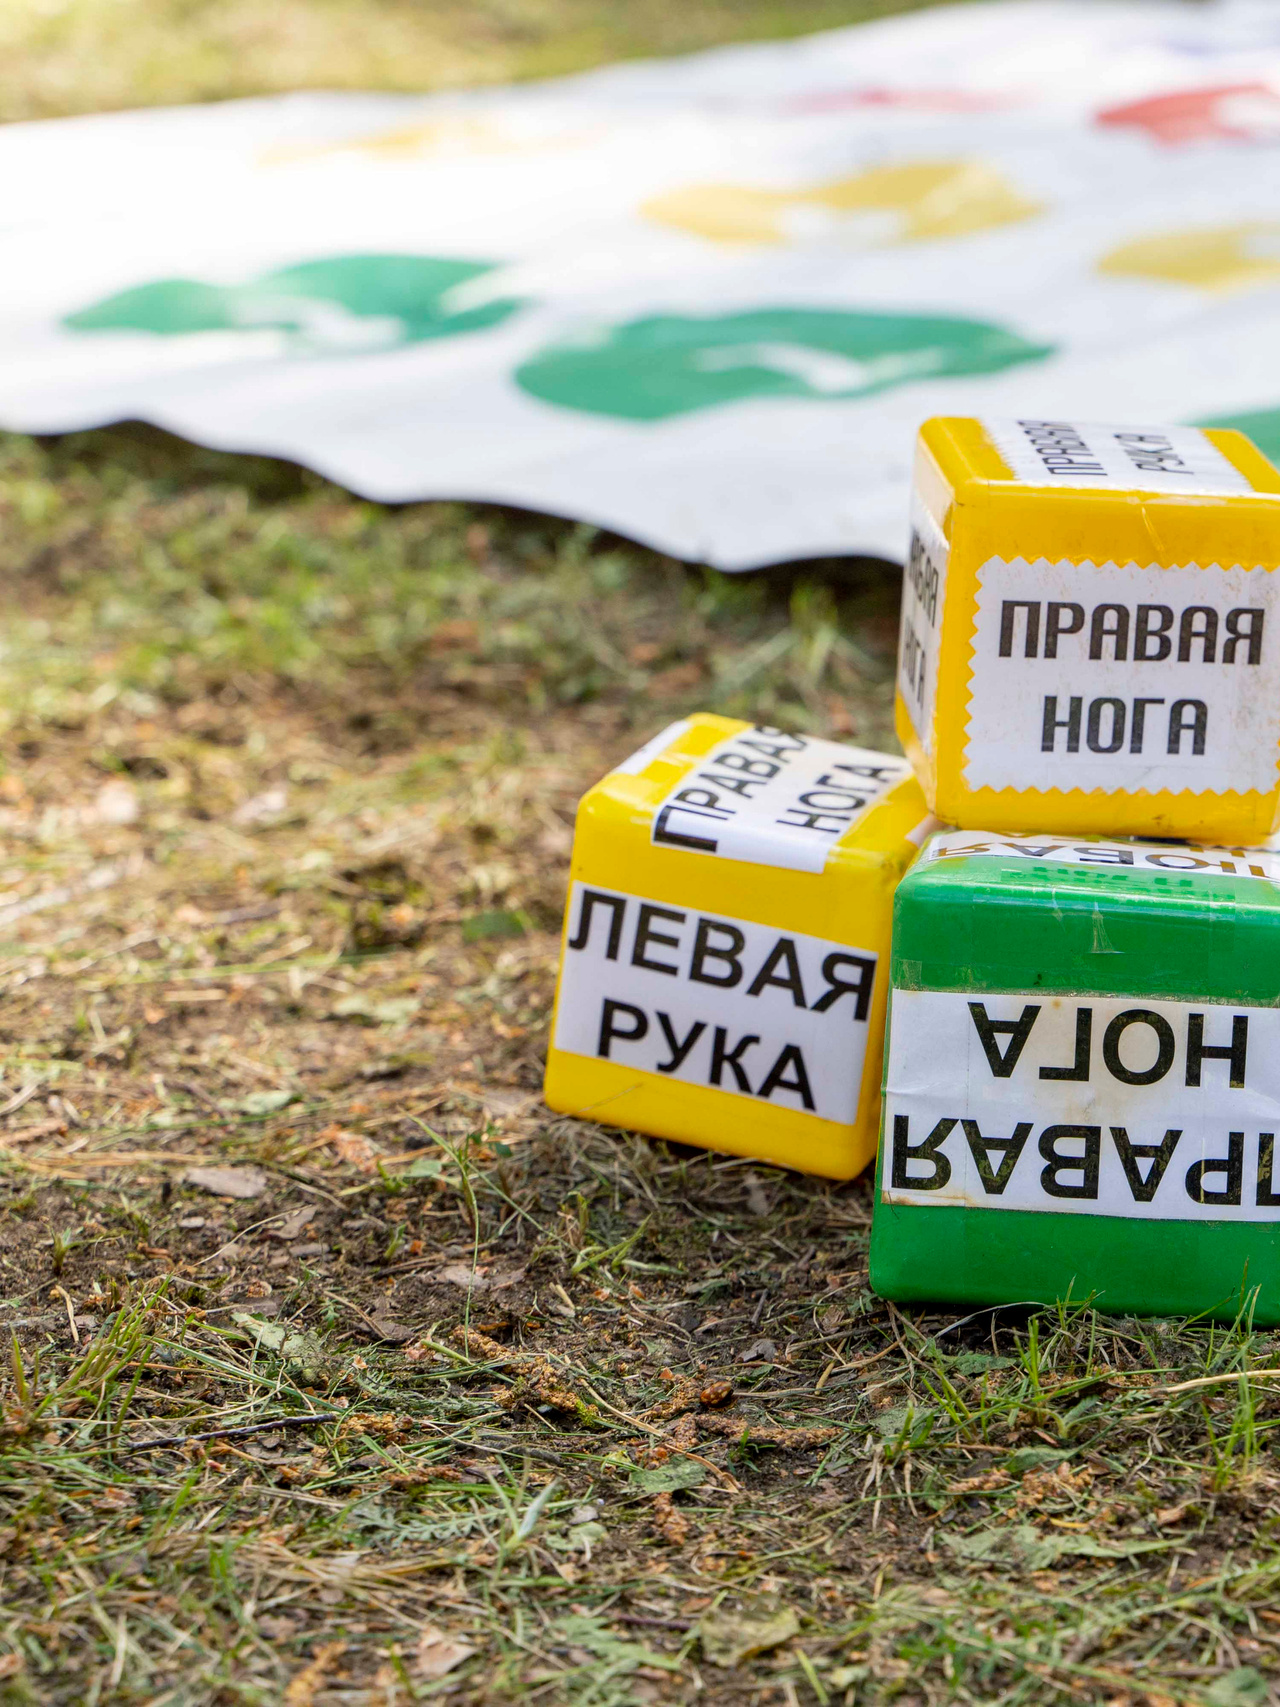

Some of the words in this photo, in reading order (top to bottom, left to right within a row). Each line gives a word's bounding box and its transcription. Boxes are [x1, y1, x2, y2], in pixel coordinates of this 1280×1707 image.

[998, 600, 1265, 665] ПРАВАЯ
[1040, 695, 1209, 756] НОГА
[776, 763, 901, 834] НОГА
[568, 889, 876, 1022] ЛЕВАЯ
[598, 998, 816, 1112] РУКА
[967, 1001, 1249, 1089] НОГА
